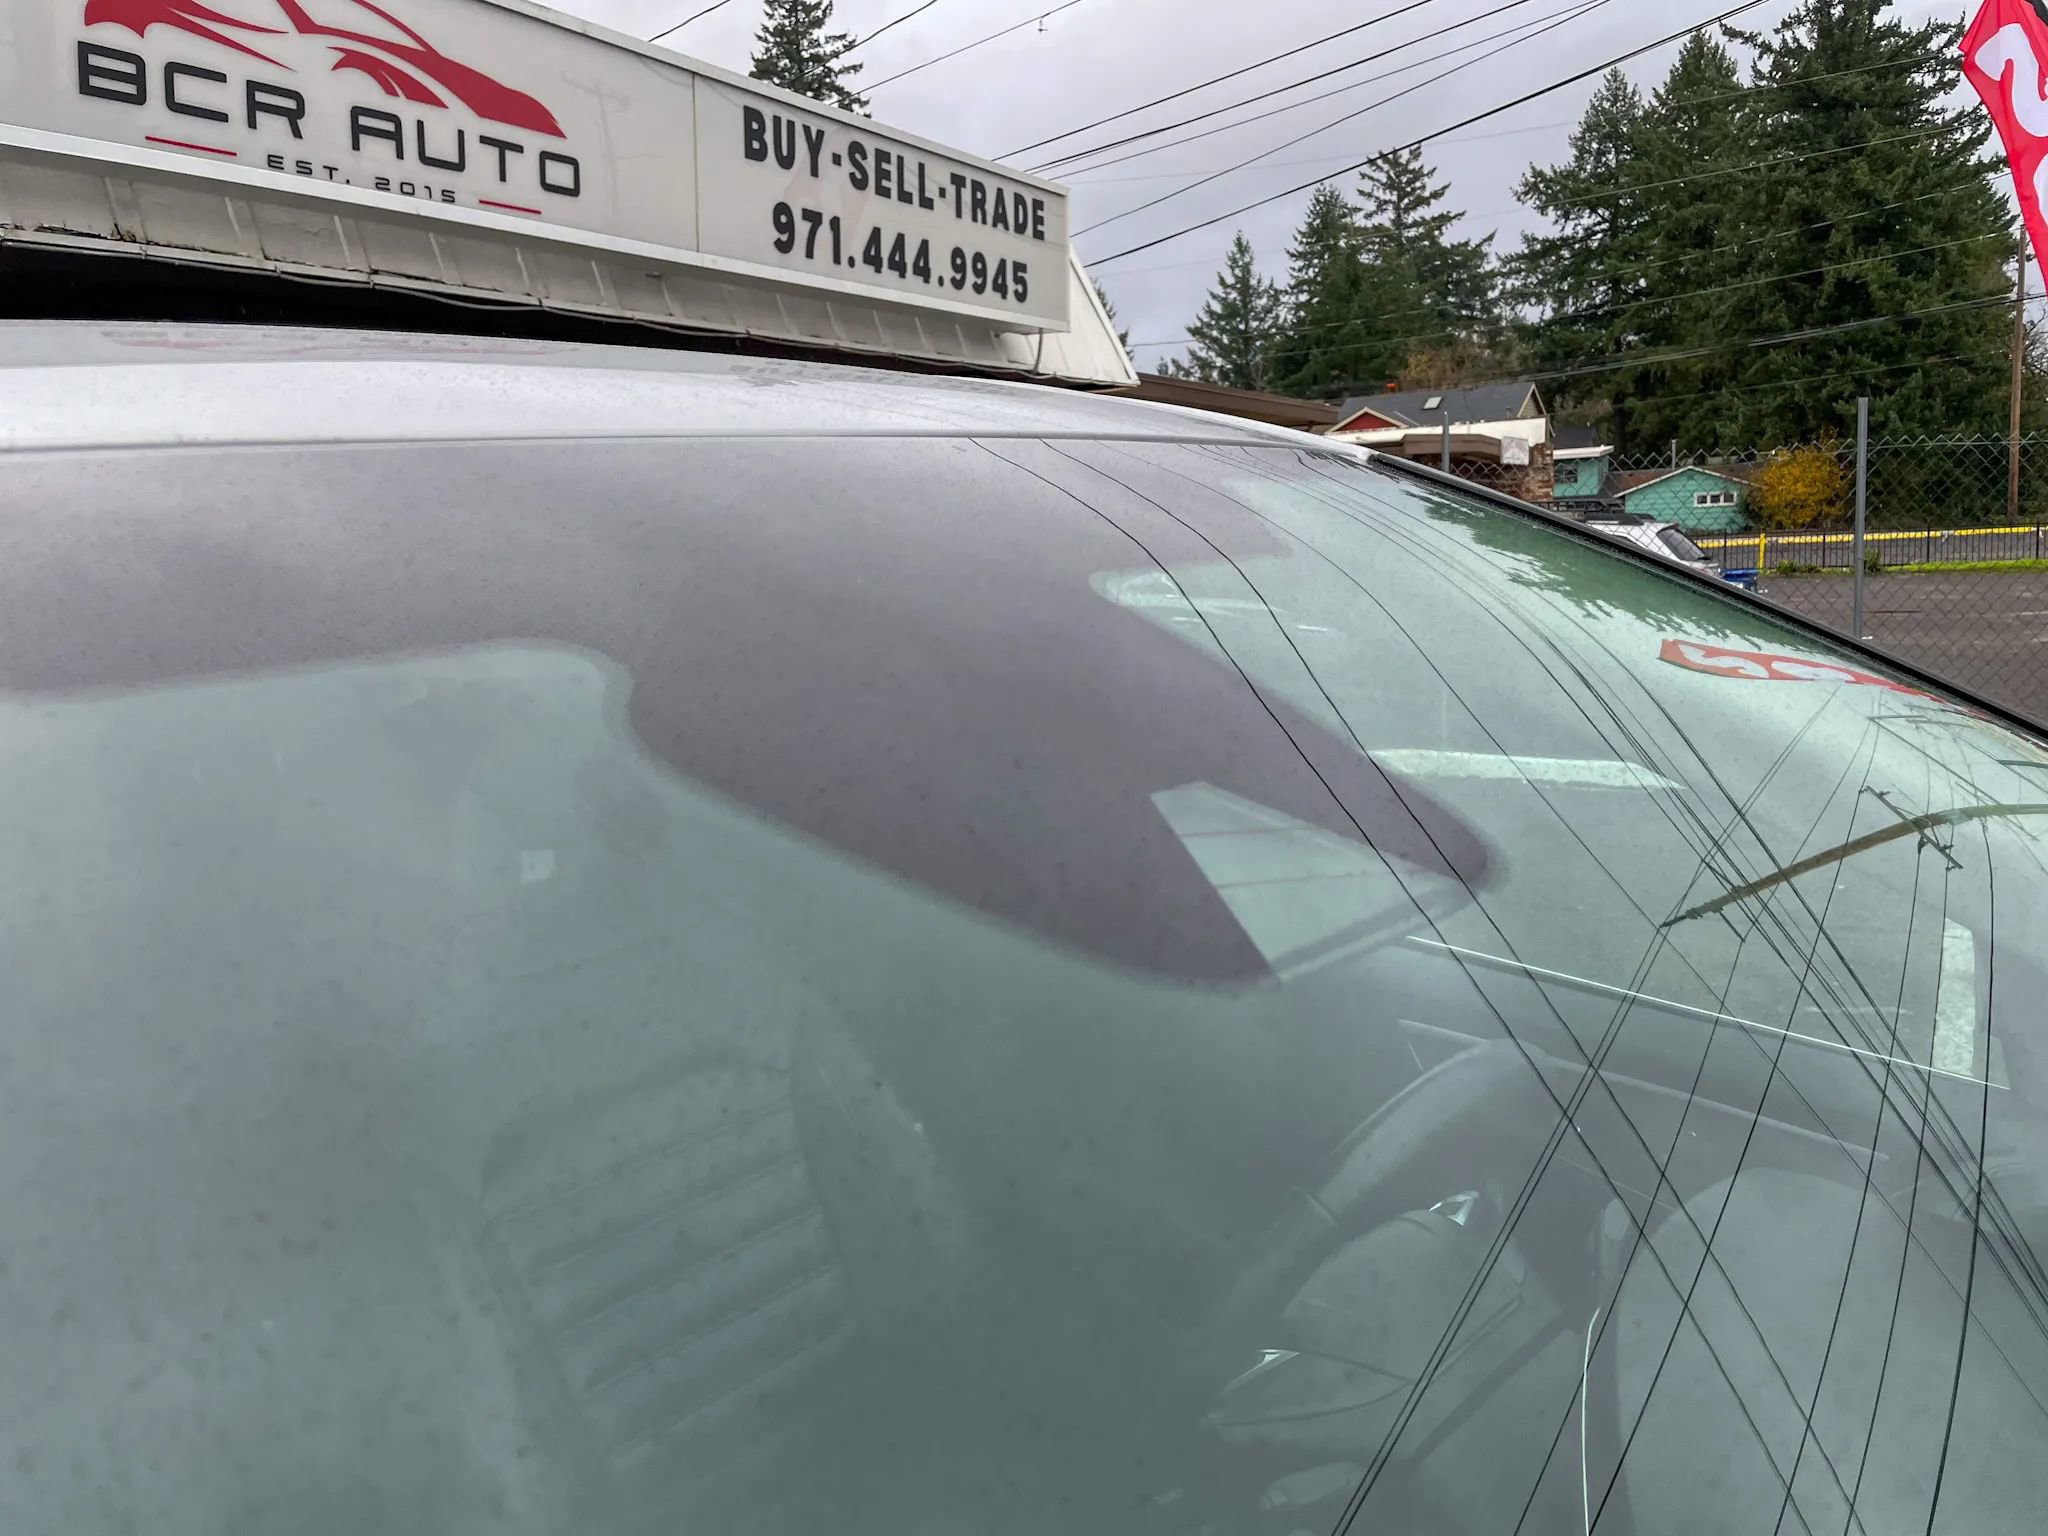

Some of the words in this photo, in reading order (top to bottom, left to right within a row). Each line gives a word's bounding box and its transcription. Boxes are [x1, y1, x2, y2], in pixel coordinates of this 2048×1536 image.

[77, 40, 306, 140] BCR
[350, 105, 581, 198] AUTO
[267, 154, 351, 184] EST.
[375, 177, 455, 203] 2015
[772, 202, 1028, 303] 971.444.9945
